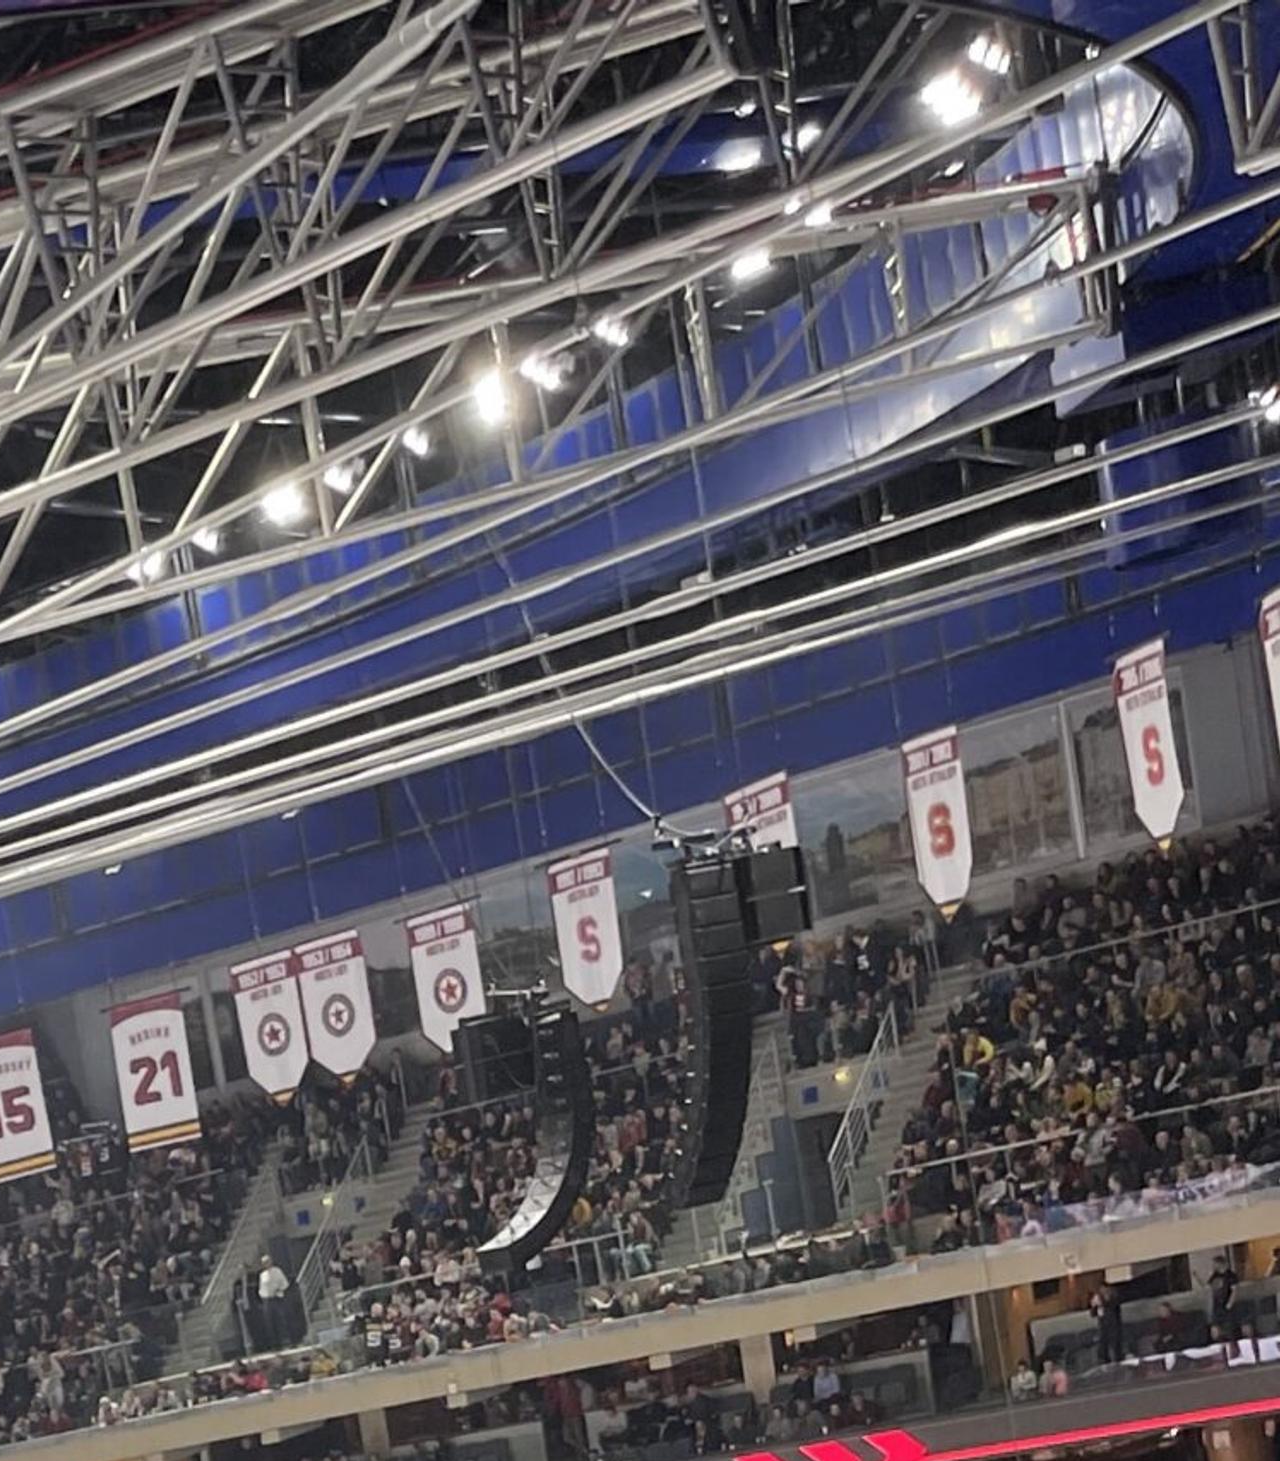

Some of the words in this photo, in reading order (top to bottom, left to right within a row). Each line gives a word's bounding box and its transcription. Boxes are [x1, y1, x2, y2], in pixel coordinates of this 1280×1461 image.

[1142, 724, 1164, 785] S
[928, 804, 955, 856] S
[576, 915, 602, 963] S
[129, 1050, 183, 1106] 21
